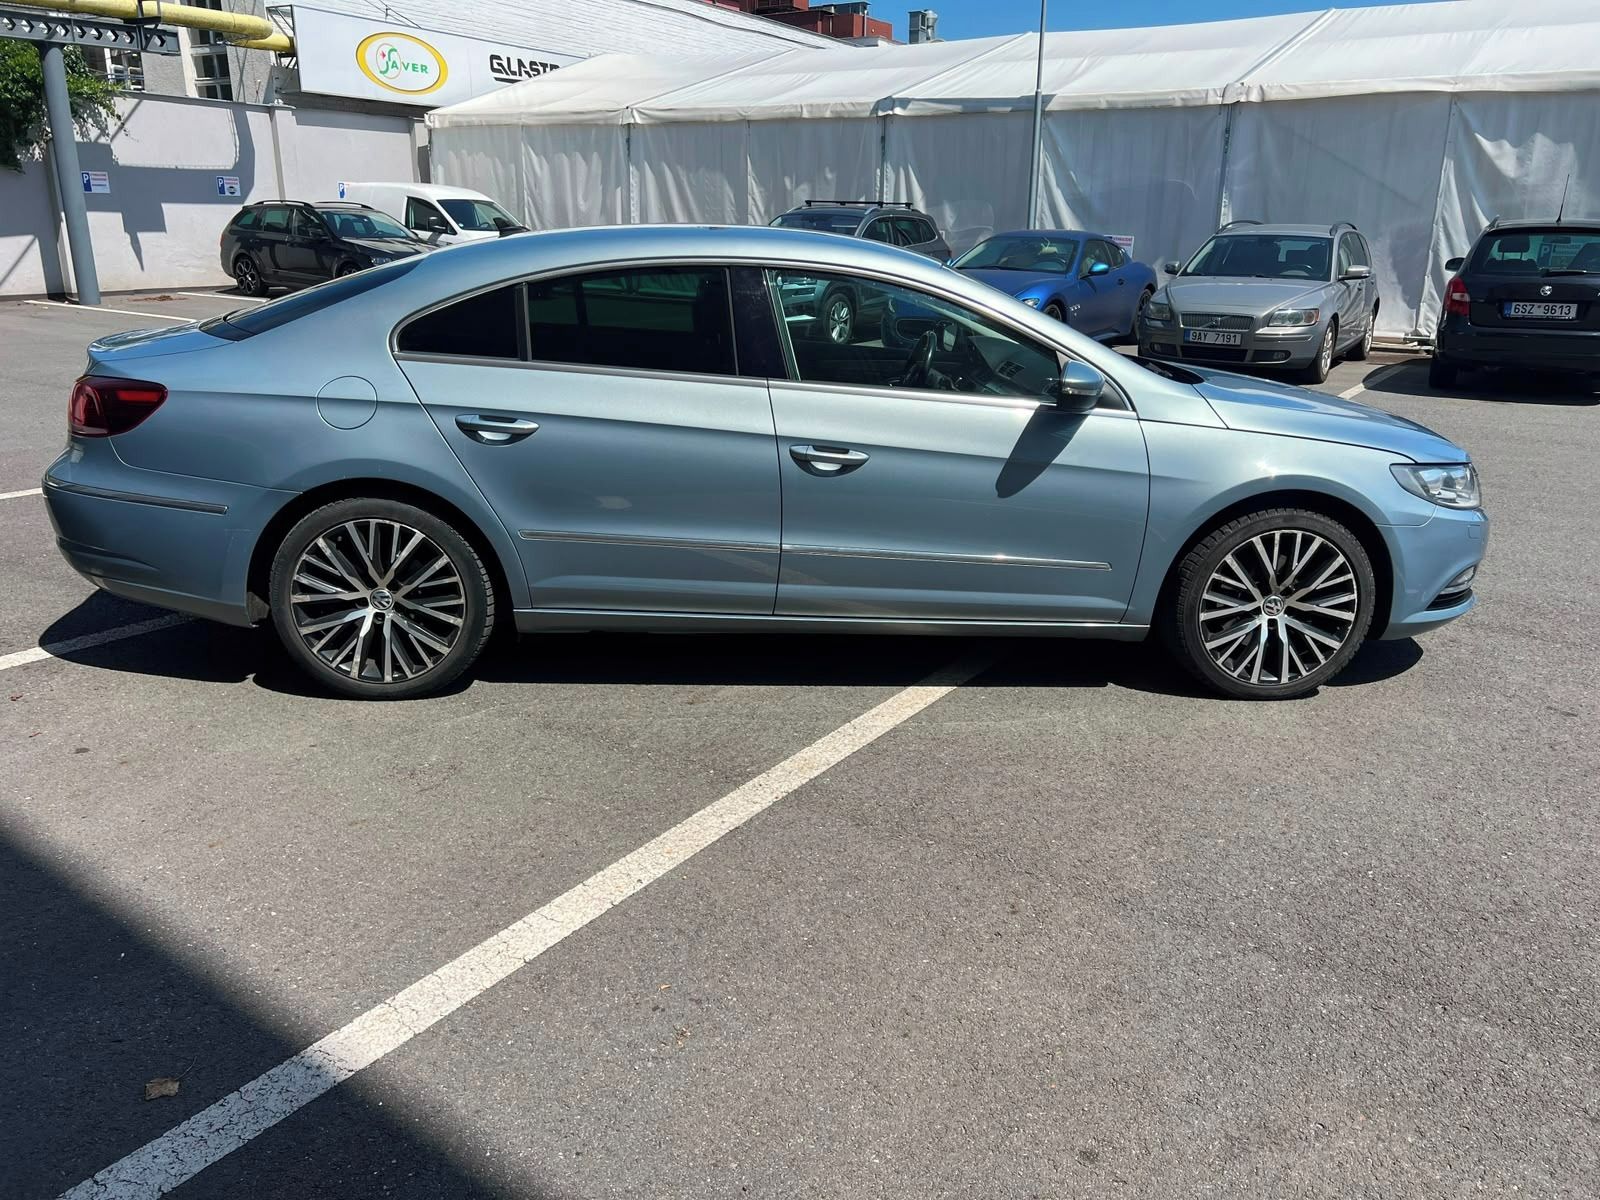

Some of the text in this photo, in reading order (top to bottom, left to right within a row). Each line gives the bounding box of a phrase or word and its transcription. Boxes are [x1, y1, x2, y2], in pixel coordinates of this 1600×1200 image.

[379, 47, 429, 74] SAVER
[83, 173, 89, 183] P
[218, 178, 224, 187] P
[1513, 303, 1572, 316] 6SZ 9613
[1191, 331, 1238, 344] 9AY 7191
